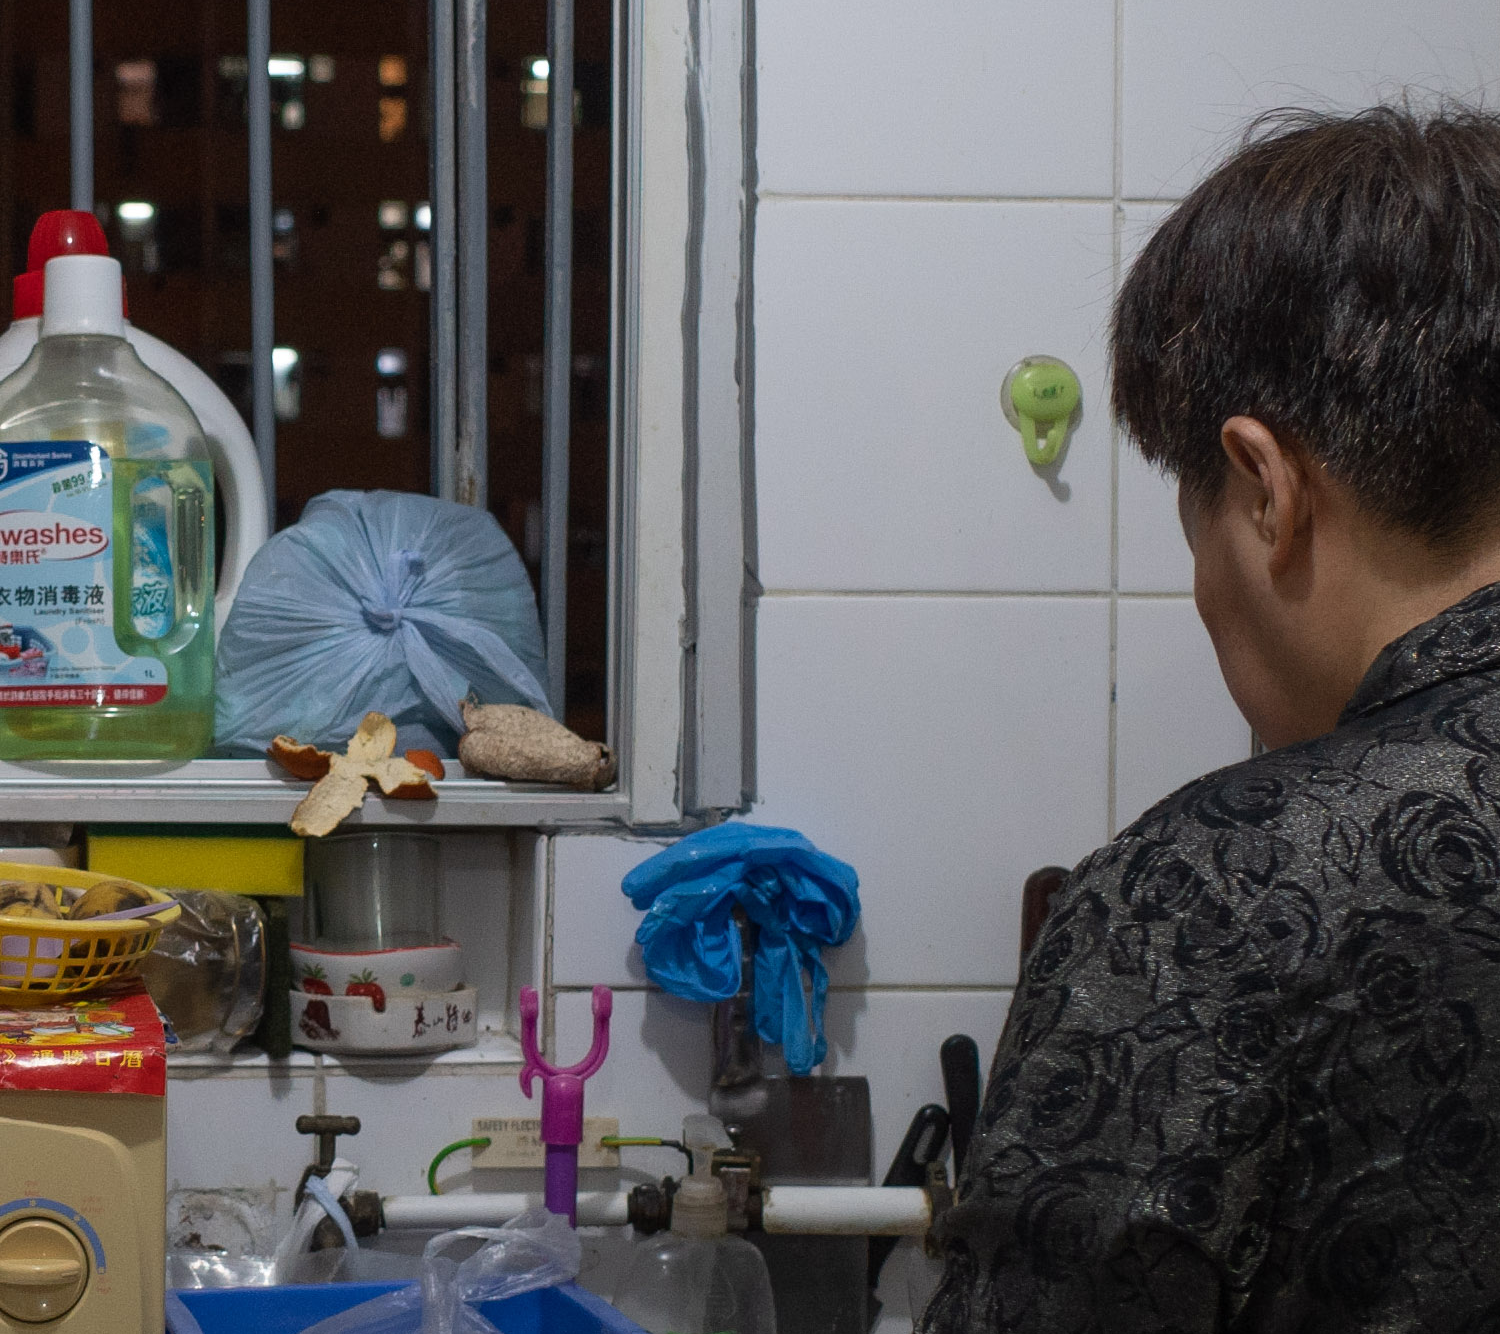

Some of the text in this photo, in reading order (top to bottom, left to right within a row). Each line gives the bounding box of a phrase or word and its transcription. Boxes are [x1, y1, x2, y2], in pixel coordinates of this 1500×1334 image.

[34, 608, 67, 617] Laundry
[31, 1048, 144, 1068] 通勝日曆
[477, 1120, 509, 1132] SAFETY
